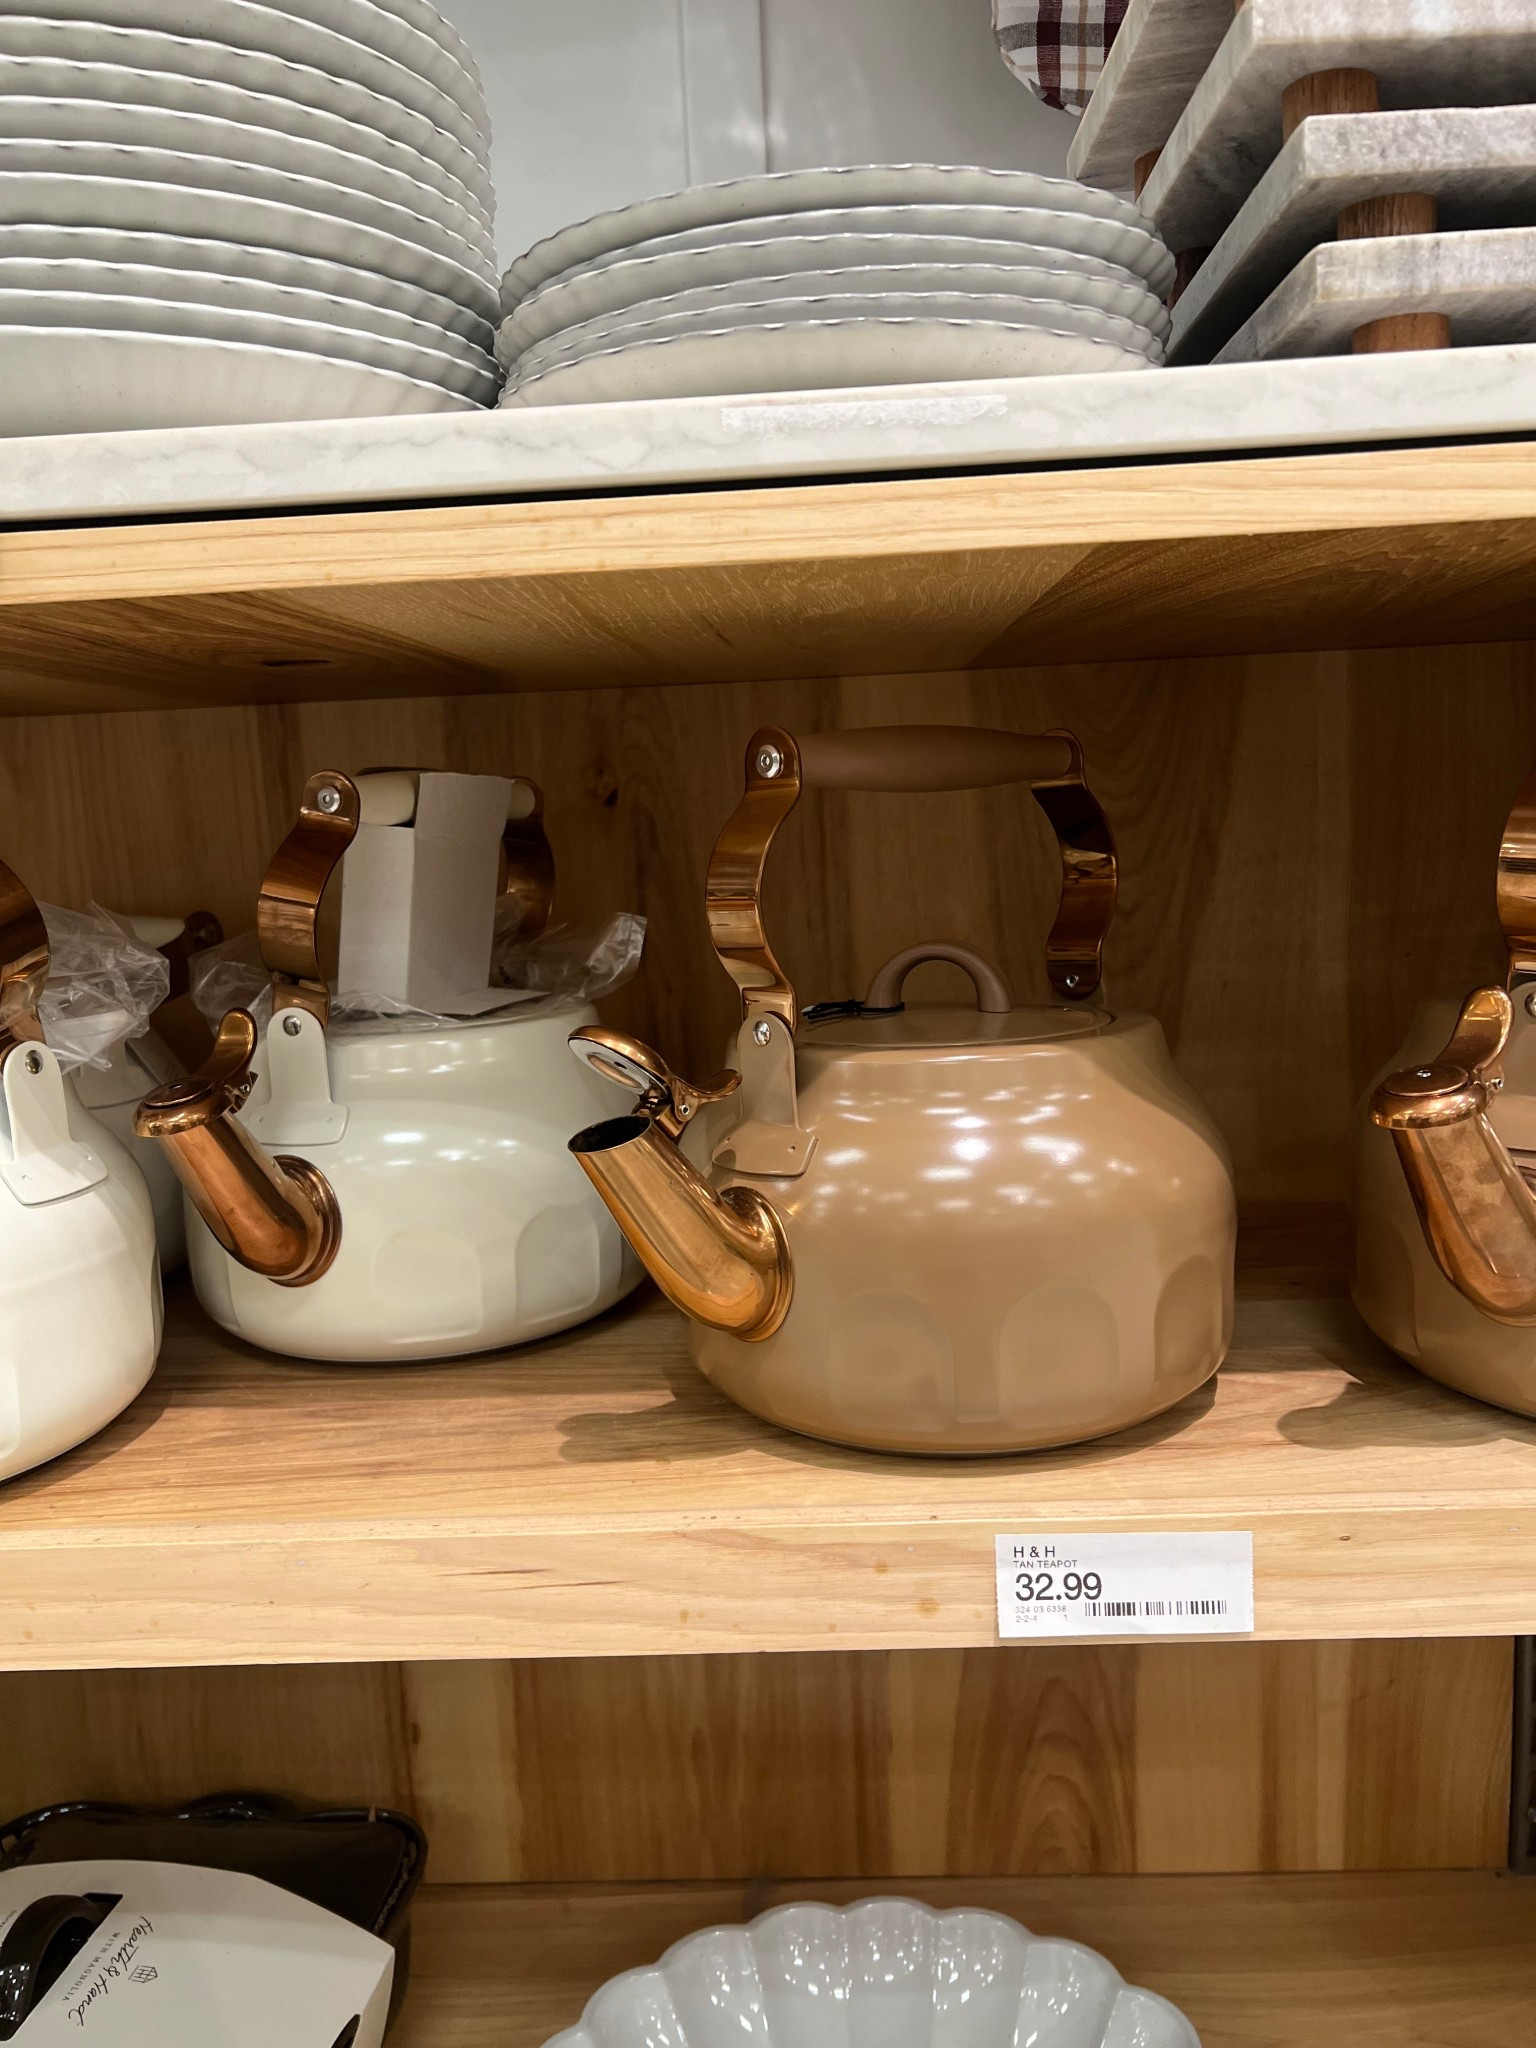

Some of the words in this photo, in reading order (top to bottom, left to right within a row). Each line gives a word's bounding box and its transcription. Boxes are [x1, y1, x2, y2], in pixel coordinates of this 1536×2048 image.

[1013, 1546, 1024, 1558] H
[1029, 1546, 1040, 1558] &
[1045, 1546, 1055, 1558] H
[1013, 1559, 1034, 1569] TAN
[1037, 1560, 1078, 1568] TEAPOT
[1015, 1572, 1102, 1601] 32.99
[1015, 1605, 1031, 1614] 324
[1033, 1605, 1044, 1613] 03
[1015, 1614, 1038, 1623] 2-2-4
[100, 1931, 121, 1954] WITH
[111, 1916, 154, 1970] Hearth
[62, 1956, 101, 2002] MAGNOLIA
[68, 1974, 109, 2027] Hand
